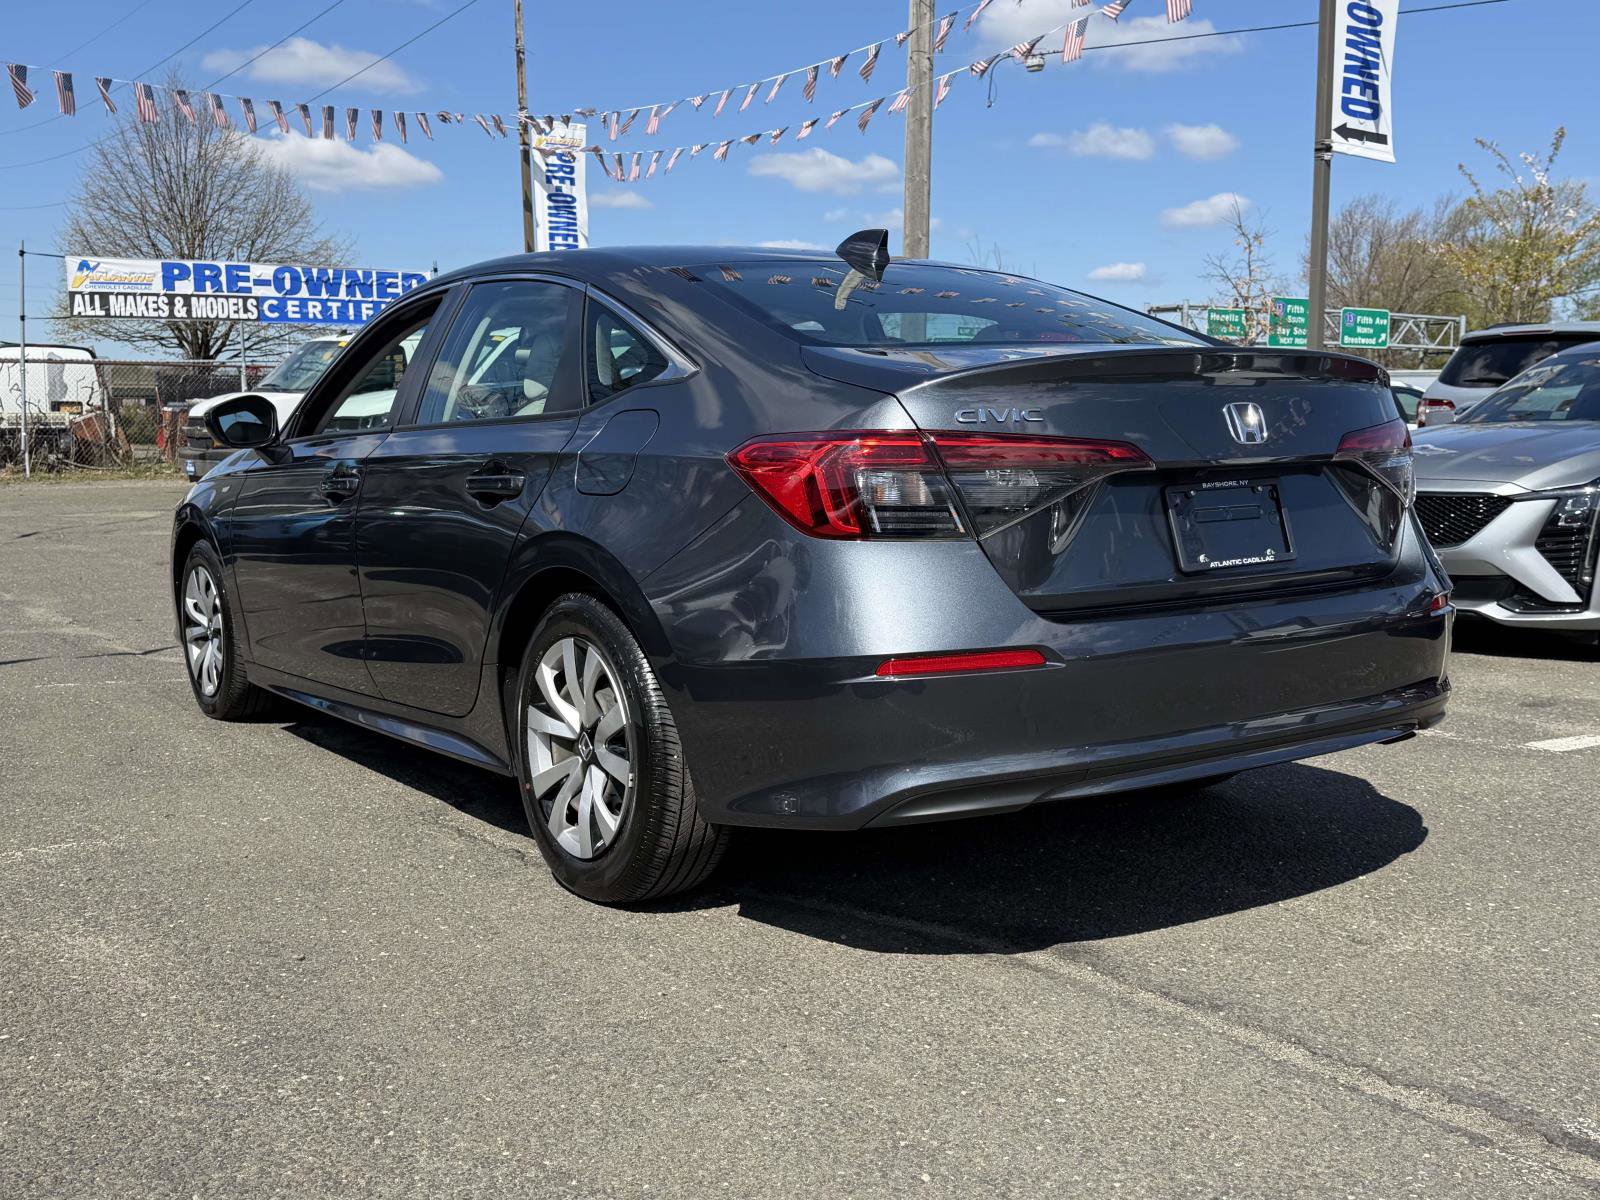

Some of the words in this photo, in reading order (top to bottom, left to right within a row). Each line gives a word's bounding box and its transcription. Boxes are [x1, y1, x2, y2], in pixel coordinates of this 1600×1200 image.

[73, 294, 105, 316] ALL
[109, 295, 170, 318] MAKES
[173, 297, 188, 318] &
[191, 297, 258, 320] MODELS
[1287, 304, 1305, 314] Fifth
[1356, 315, 1374, 324] Fifth
[1375, 316, 1388, 325] Ave
[1293, 326, 1307, 335] Sho
[1343, 335, 1376, 345] Brentwood
[953, 407, 1044, 424] CIVIC
[1210, 559, 1242, 568] ATLANTIC
[1242, 556, 1275, 564] CADILLAC
